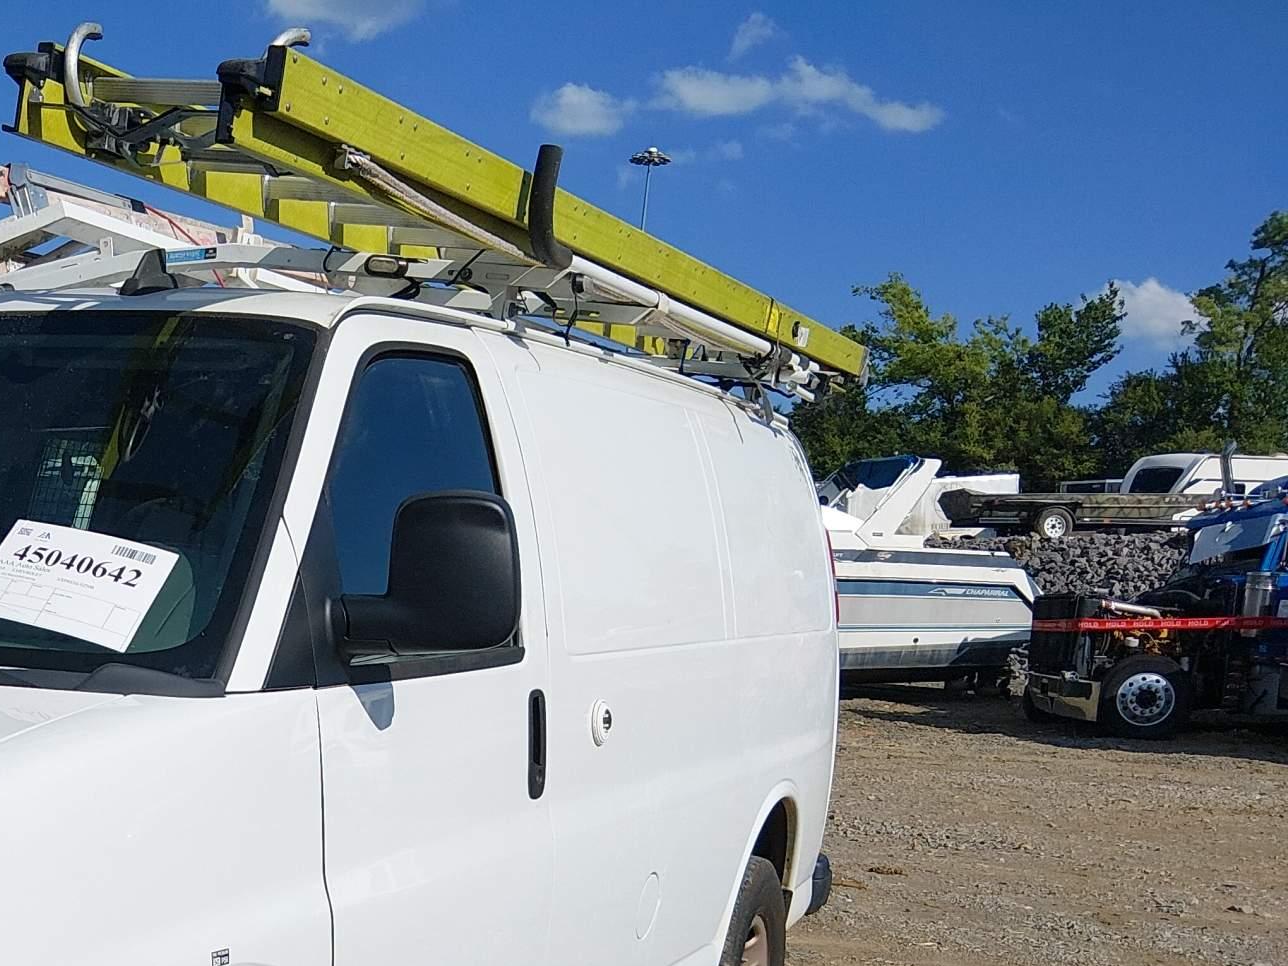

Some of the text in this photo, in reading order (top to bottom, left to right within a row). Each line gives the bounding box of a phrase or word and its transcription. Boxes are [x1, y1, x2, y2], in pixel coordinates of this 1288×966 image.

[13, 544, 143, 588] 45040642
[965, 588, 1009, 597] CHAPARRAL
[1105, 620, 1127, 628] HOLD
[1132, 620, 1154, 628] HOLD
